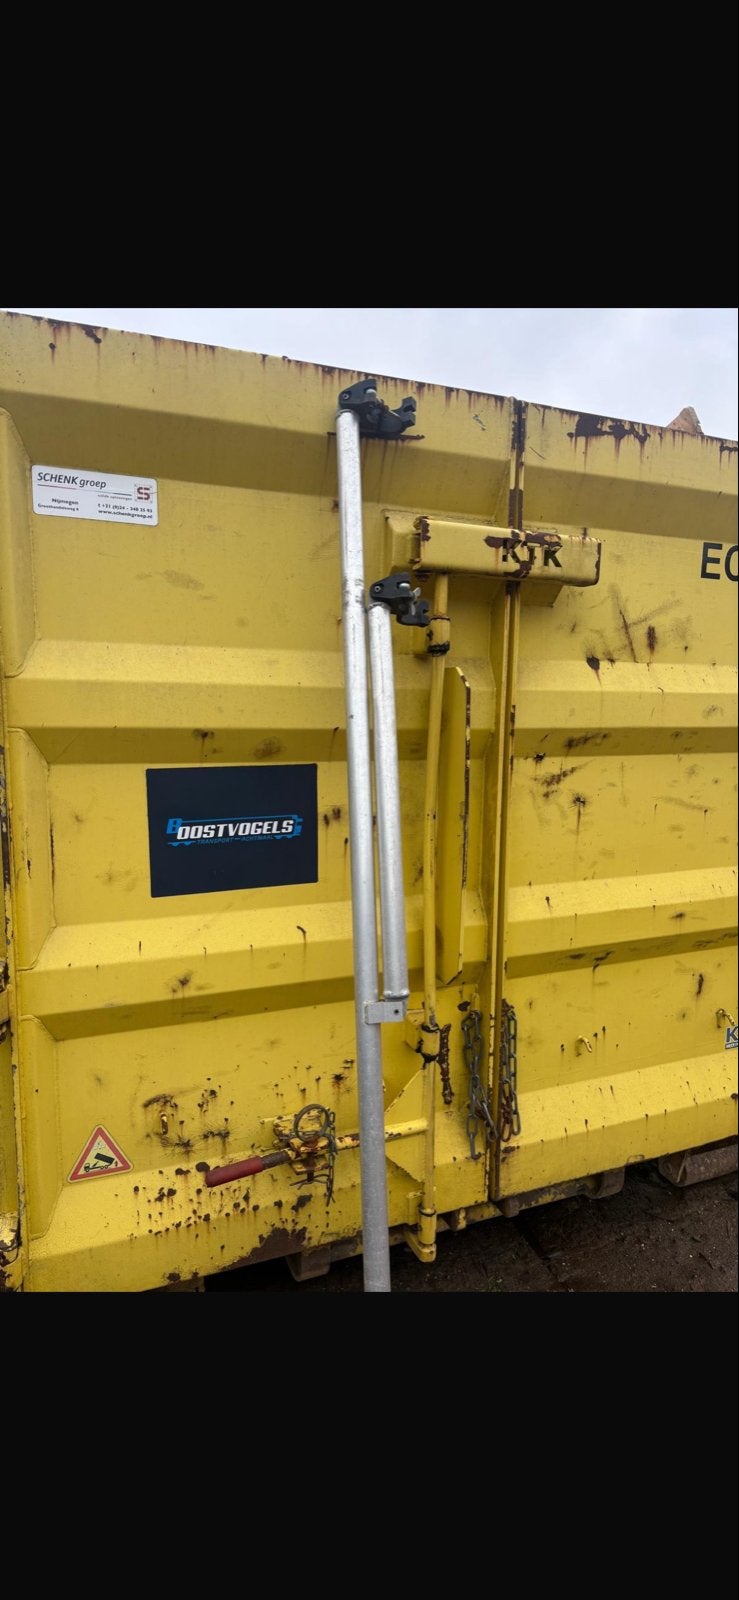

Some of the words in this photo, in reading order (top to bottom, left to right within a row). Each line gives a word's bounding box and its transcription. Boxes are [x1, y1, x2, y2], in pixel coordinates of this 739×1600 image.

[37, 472, 79, 485] SCHENK
[79, 478, 107, 490] groep
[98, 510, 153, 519] www.schenkgroep.nl
[501, 539, 563, 568] KTK
[166, 817, 295, 840] BOOSTVOGELS
[197, 837, 234, 845] TRANSPORT
